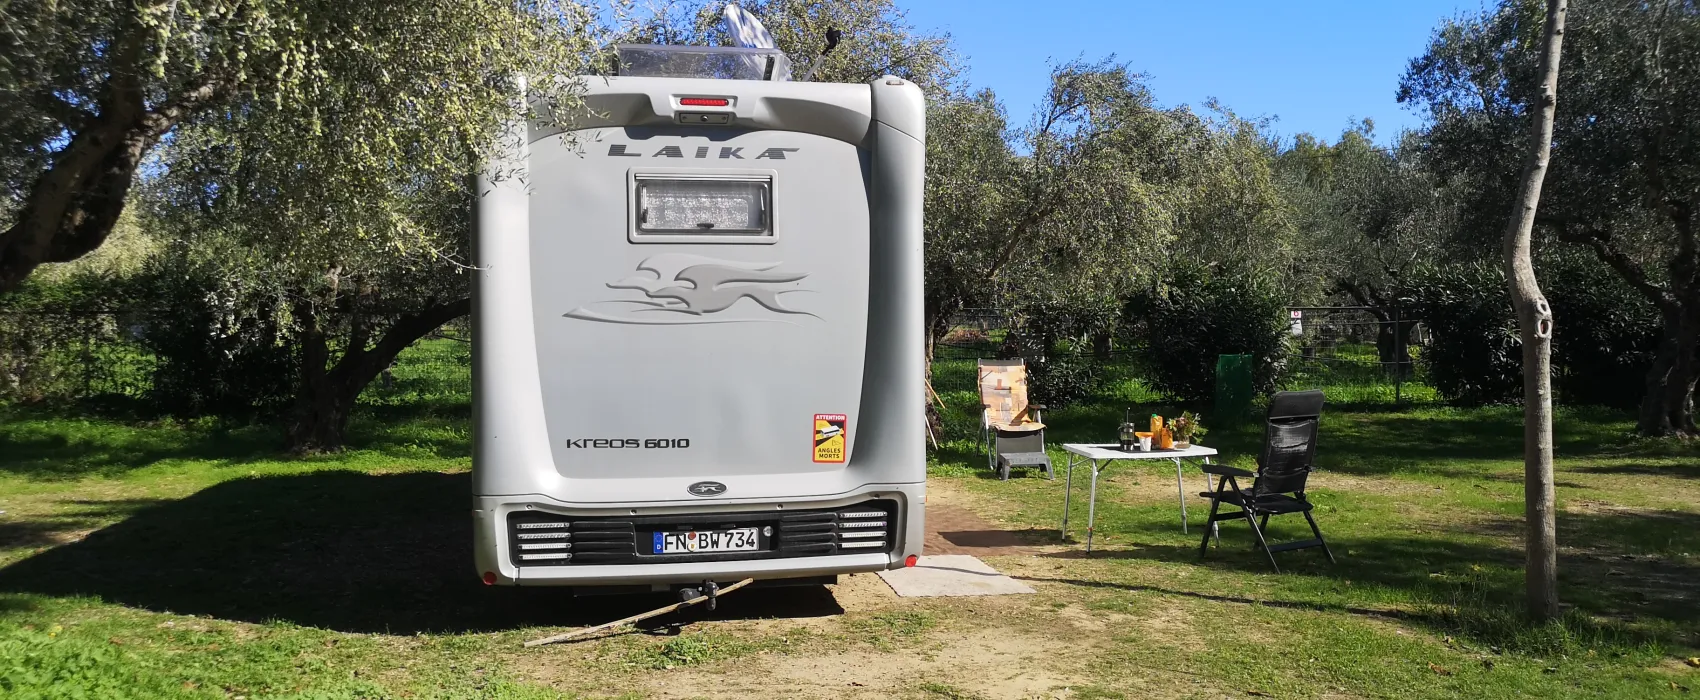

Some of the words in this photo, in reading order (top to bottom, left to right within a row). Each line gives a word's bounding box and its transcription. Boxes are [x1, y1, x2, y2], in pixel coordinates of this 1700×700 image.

[607, 144, 800, 160] LAIKA
[644, 438, 690, 449] 6010
[664, 533, 687, 551] FN
[698, 532, 720, 550] BW
[724, 530, 756, 549] 734
